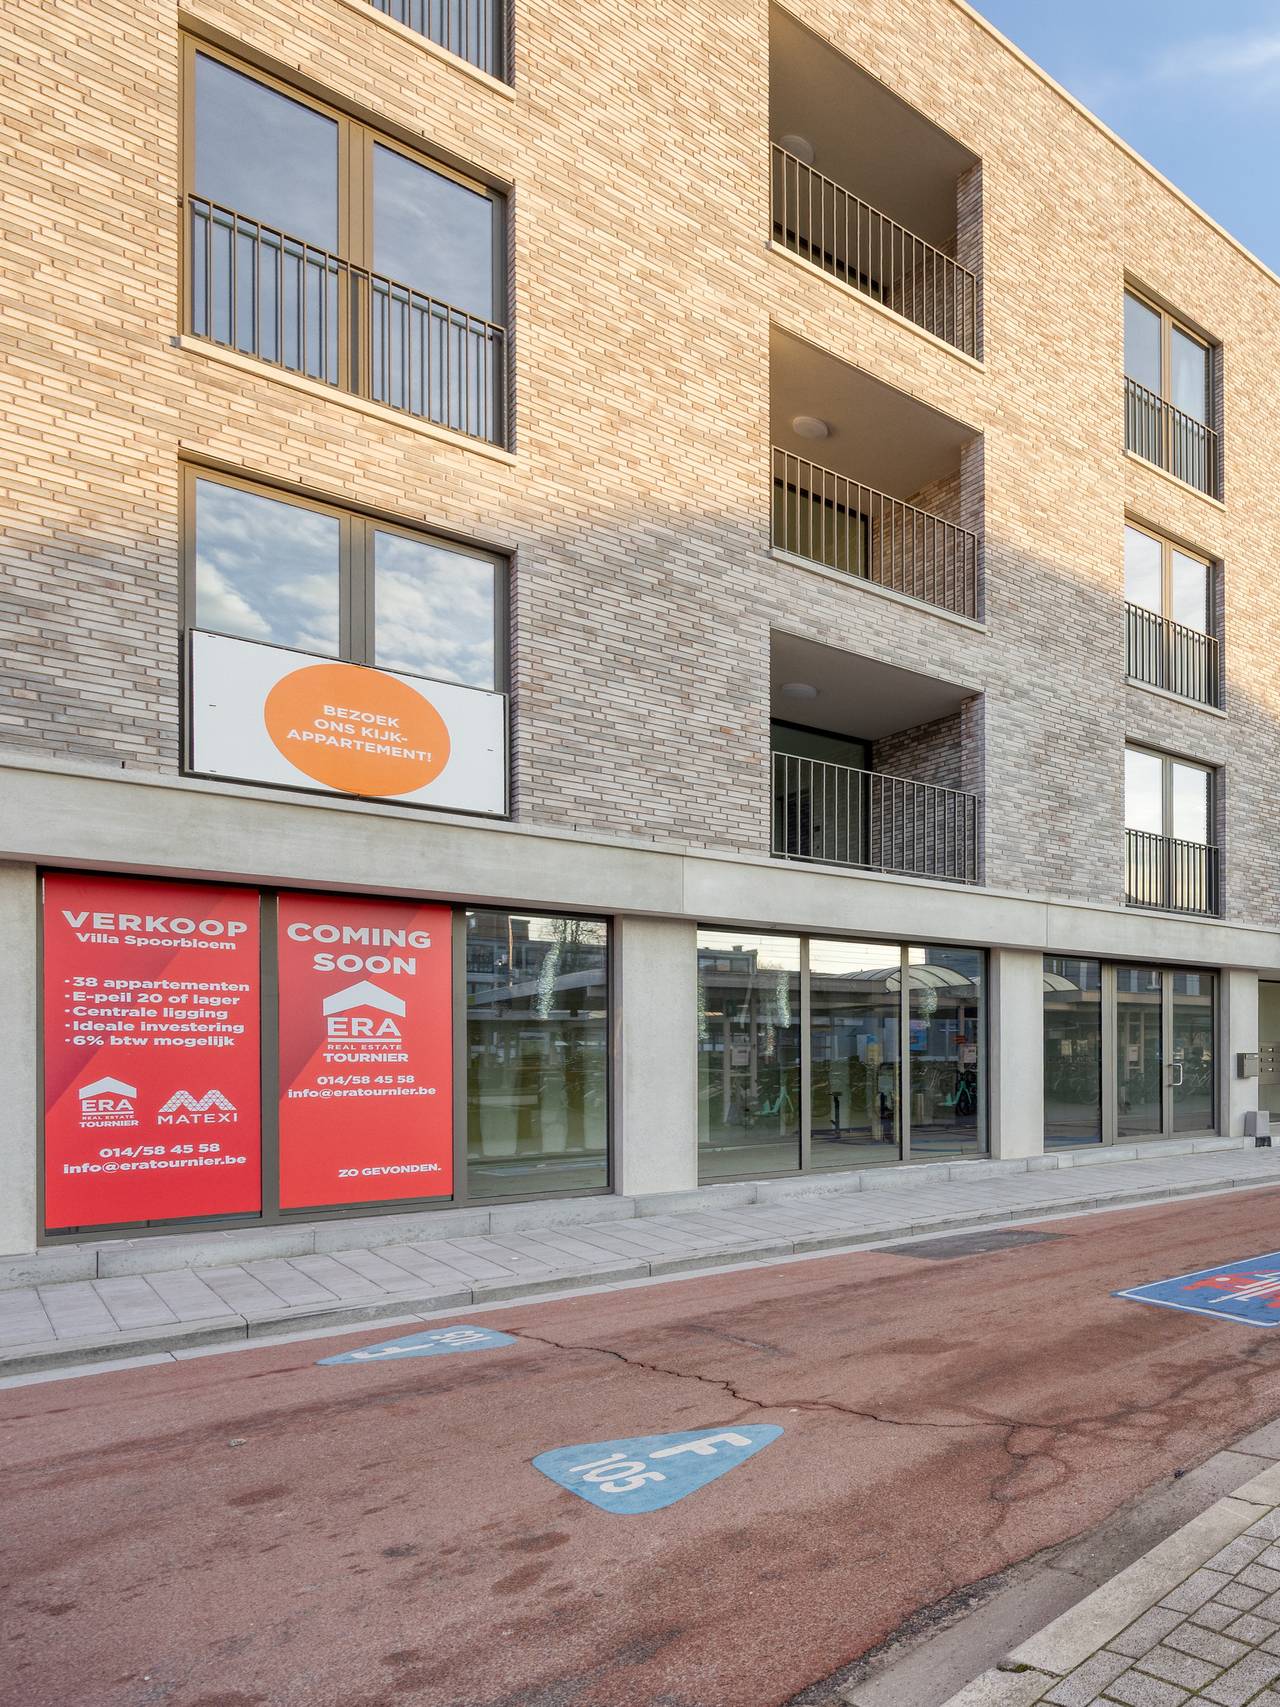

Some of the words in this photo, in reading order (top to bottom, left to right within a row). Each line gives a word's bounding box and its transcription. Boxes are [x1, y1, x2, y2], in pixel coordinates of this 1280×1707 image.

[323, 704, 400, 728] BEZOEK
[314, 718, 355, 736] ONS
[361, 726, 408, 743] KIJK-
[287, 728, 432, 763] APPARTEMENT!
[61, 910, 248, 937] VERKOOP
[76, 932, 119, 944] Villa
[124, 935, 236, 950] Spoorbloem
[287, 922, 432, 949] COMING
[312, 952, 416, 975] SOON
[72, 976, 98, 987] 38
[103, 978, 250, 992] appartementen
[72, 991, 132, 1004] E-peil
[137, 993, 163, 1003] 20
[168, 993, 188, 1004] of
[193, 994, 240, 1006] lager
[72, 1006, 158, 1017] Centrale
[163, 1007, 228, 1020] ligging
[73, 1021, 135, 1031] Ideale
[140, 1021, 245, 1034] investering
[327, 1017, 401, 1036] ERA
[73, 1035, 104, 1046] 6%
[110, 1035, 149, 1046] btw
[153, 1036, 235, 1047] mogelijk
[323, 1053, 409, 1063] TOURNIER
[316, 1075, 371, 1086] 014/58
[374, 1075, 393, 1084] 45
[397, 1075, 415, 1084] 58
[288, 1086, 437, 1099] info@eratournier.be
[82, 1099, 134, 1112] ERA
[79, 1120, 139, 1128] TOURNIER
[157, 1113, 238, 1125] MATEXI
[99, 1145, 165, 1158] 014/58
[170, 1144, 193, 1154] 45
[199, 1143, 220, 1153] 58
[63, 1155, 247, 1174] info@eratournier.be
[338, 1168, 359, 1178] ZO
[362, 1163, 442, 1176] GEVONDEN.
[649, 1432, 752, 1459] F
[569, 1453, 666, 1493] 105
